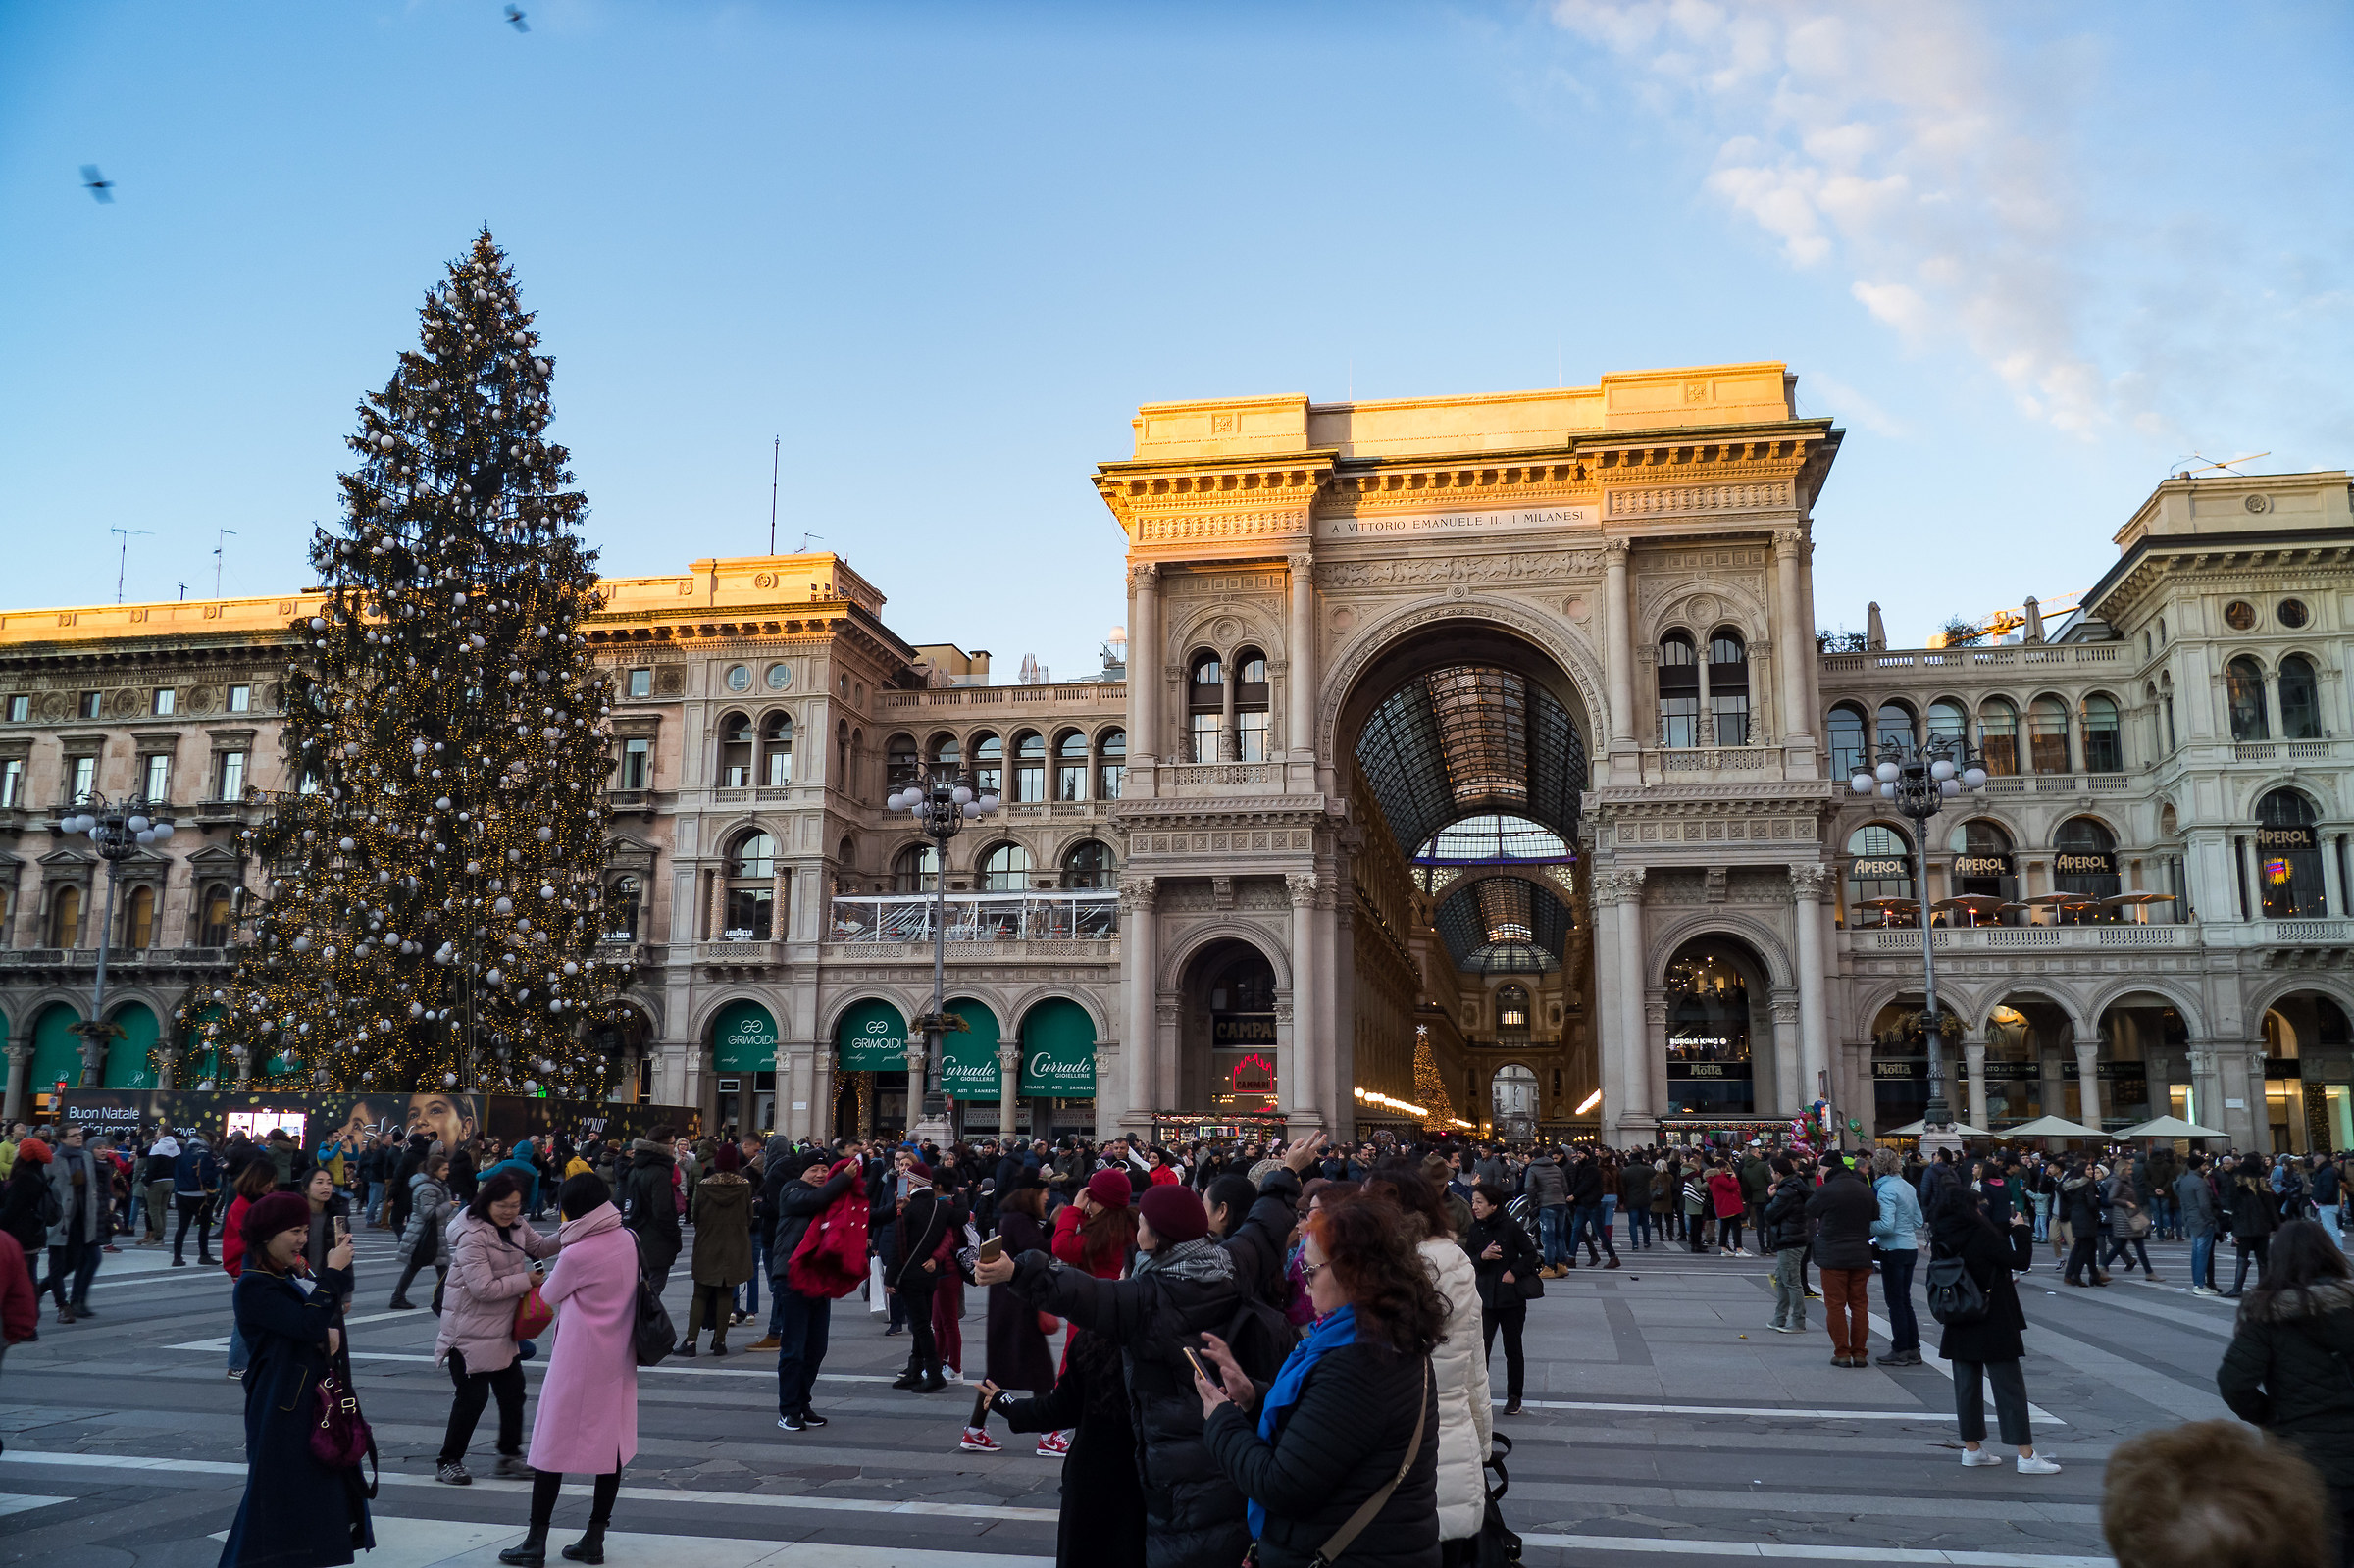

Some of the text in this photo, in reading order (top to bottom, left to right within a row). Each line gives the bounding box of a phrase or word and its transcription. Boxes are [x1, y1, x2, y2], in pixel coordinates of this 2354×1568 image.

[1332, 525, 1340, 533] A
[1348, 521, 1406, 532] VITTORIO
[1412, 516, 1483, 530] EMANUELE
[1523, 511, 1583, 523] MILANESI
[2256, 829, 2311, 843] APEROL
[1854, 859, 1905, 874] APEROL
[1955, 856, 2006, 871] APEROL
[2057, 854, 2109, 869] APEROL
[725, 927, 753, 936] LAVAZZA
[1216, 1022, 1276, 1039] CAMPA
[728, 1035, 774, 1045] GRIMOLDI
[851, 1037, 901, 1049] GRIMOLDI
[1030, 1051, 1091, 1078] Currado
[1690, 1064, 1723, 1076] Motta
[1877, 1063, 1912, 1075] Motta
[1236, 1081, 1269, 1089] CAMPARI
[69, 1106, 140, 1120] Buon Natale
